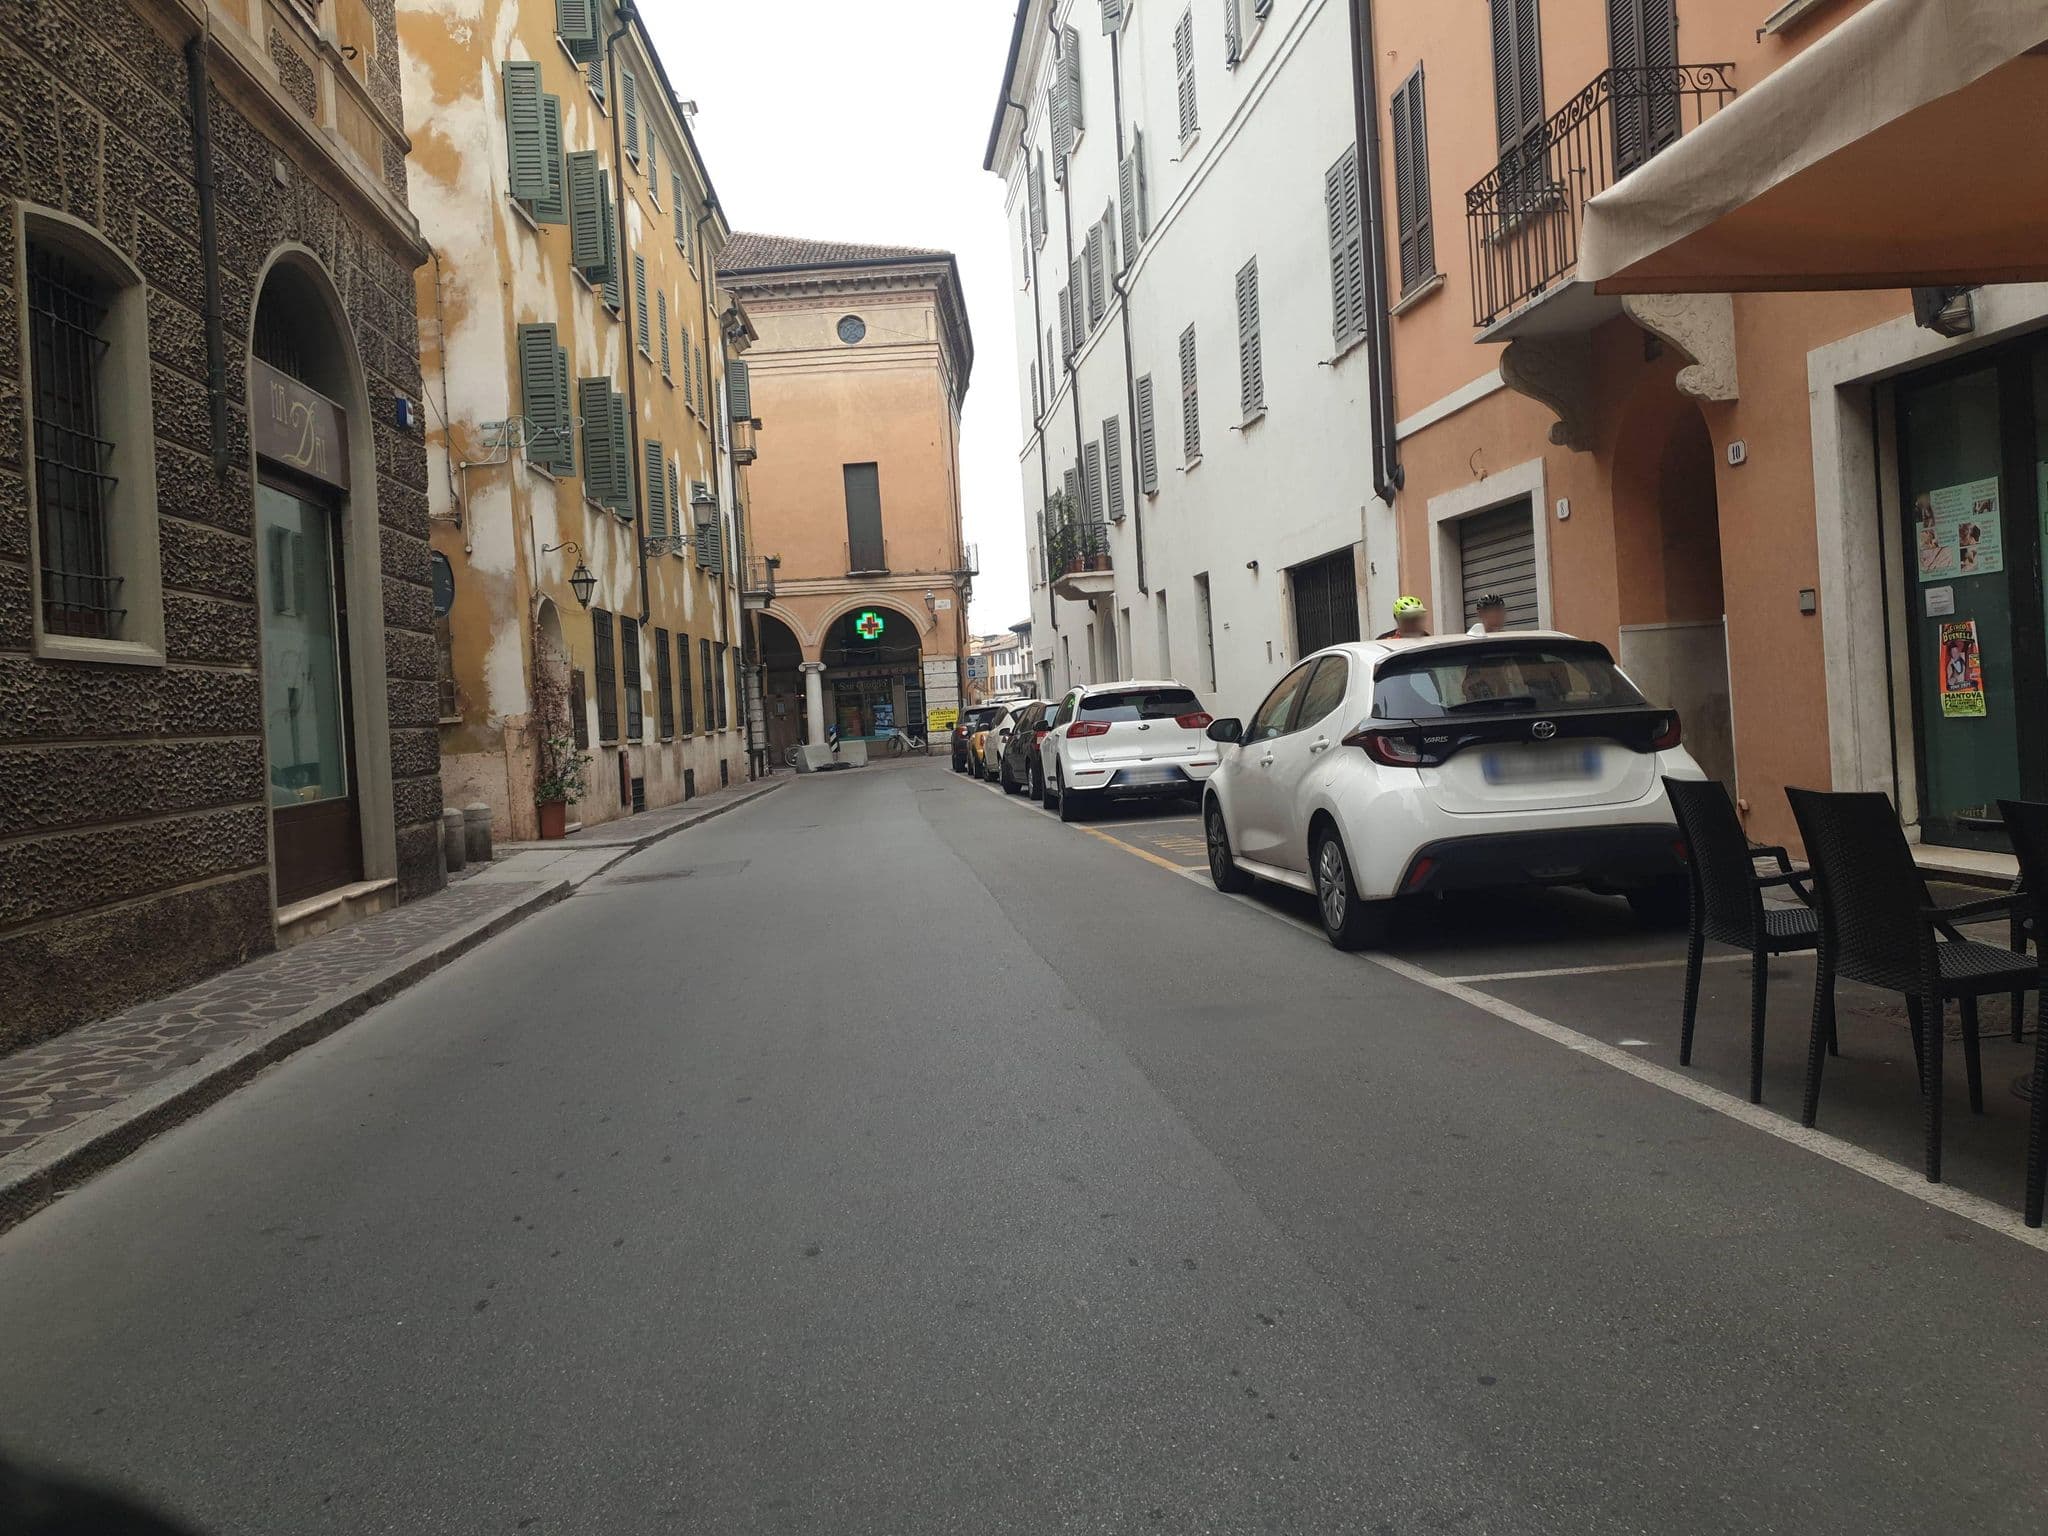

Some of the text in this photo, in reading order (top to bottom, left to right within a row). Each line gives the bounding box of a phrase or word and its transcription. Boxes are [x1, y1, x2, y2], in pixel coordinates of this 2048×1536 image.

[1731, 445, 1741, 461] 10
[1945, 692, 1982, 700] MANTOVA
[1423, 736, 1449, 744] YARIS
